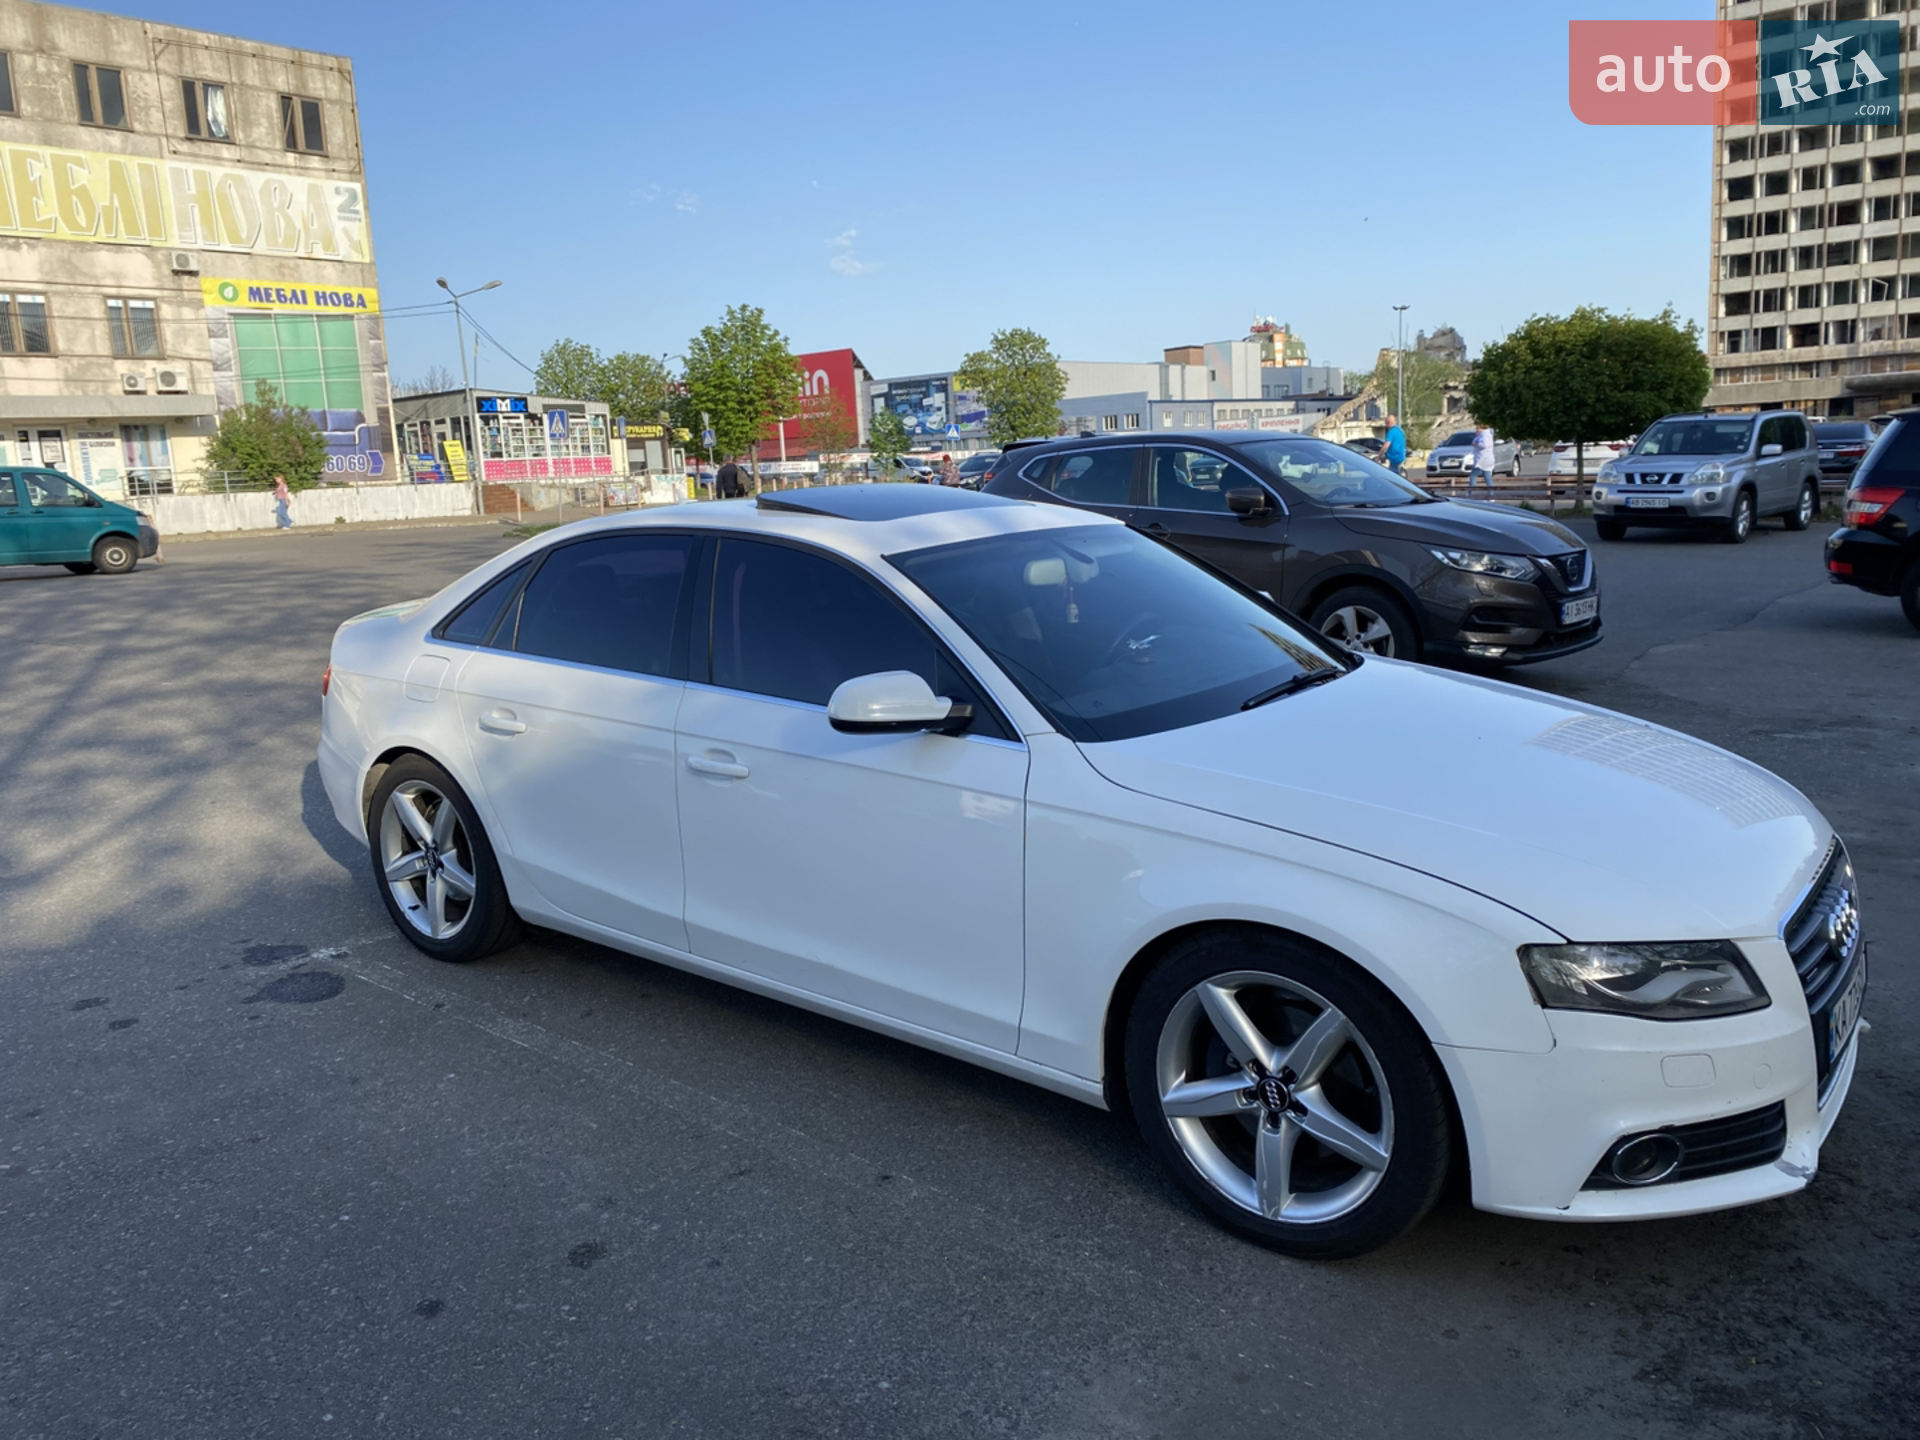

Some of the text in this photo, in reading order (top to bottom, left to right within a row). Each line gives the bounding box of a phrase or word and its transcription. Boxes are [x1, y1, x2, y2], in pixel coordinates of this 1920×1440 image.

[0, 146, 340, 256] ЕБЛІ НОВА
[334, 186, 360, 215] 2
[247, 286, 368, 309] МЕБЛІ НОВА
[325, 454, 367, 473] 60 69
